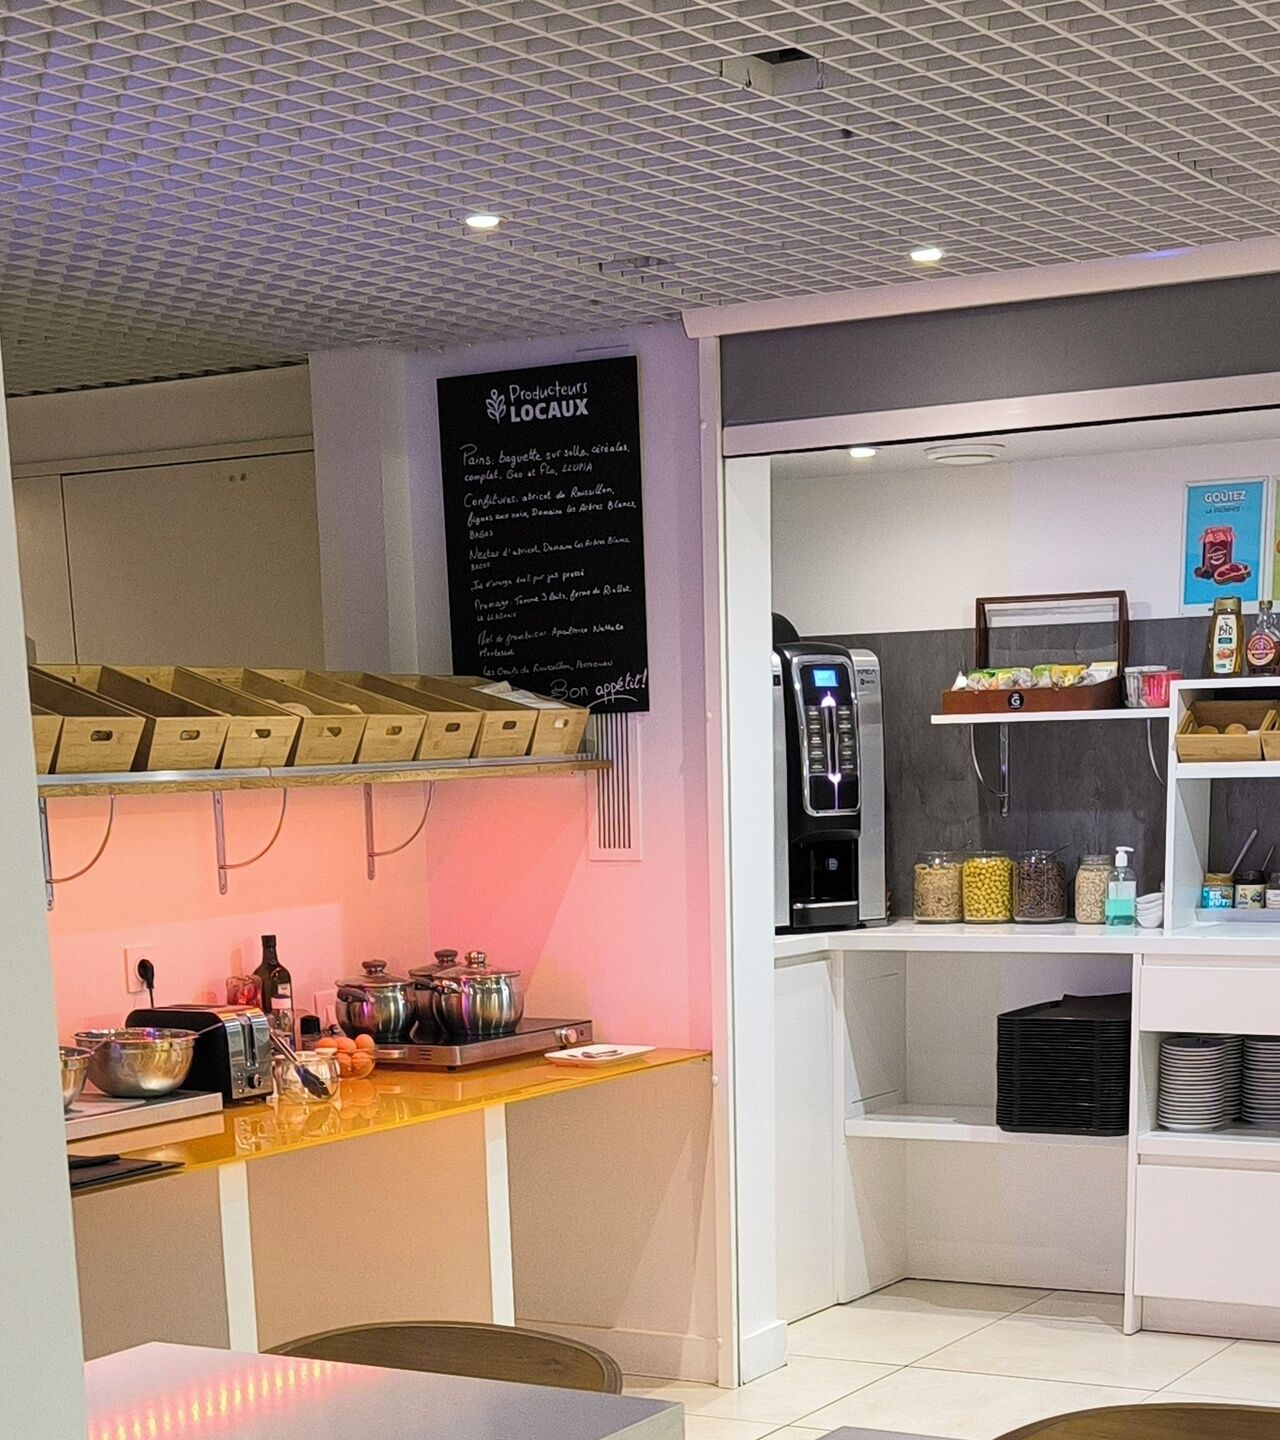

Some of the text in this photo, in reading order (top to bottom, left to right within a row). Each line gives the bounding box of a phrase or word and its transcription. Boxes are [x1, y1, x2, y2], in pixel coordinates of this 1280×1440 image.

[509, 380, 588, 403] Producteurs
[510, 398, 589, 423] LOCAUX
[550, 679, 589, 700] Bon
